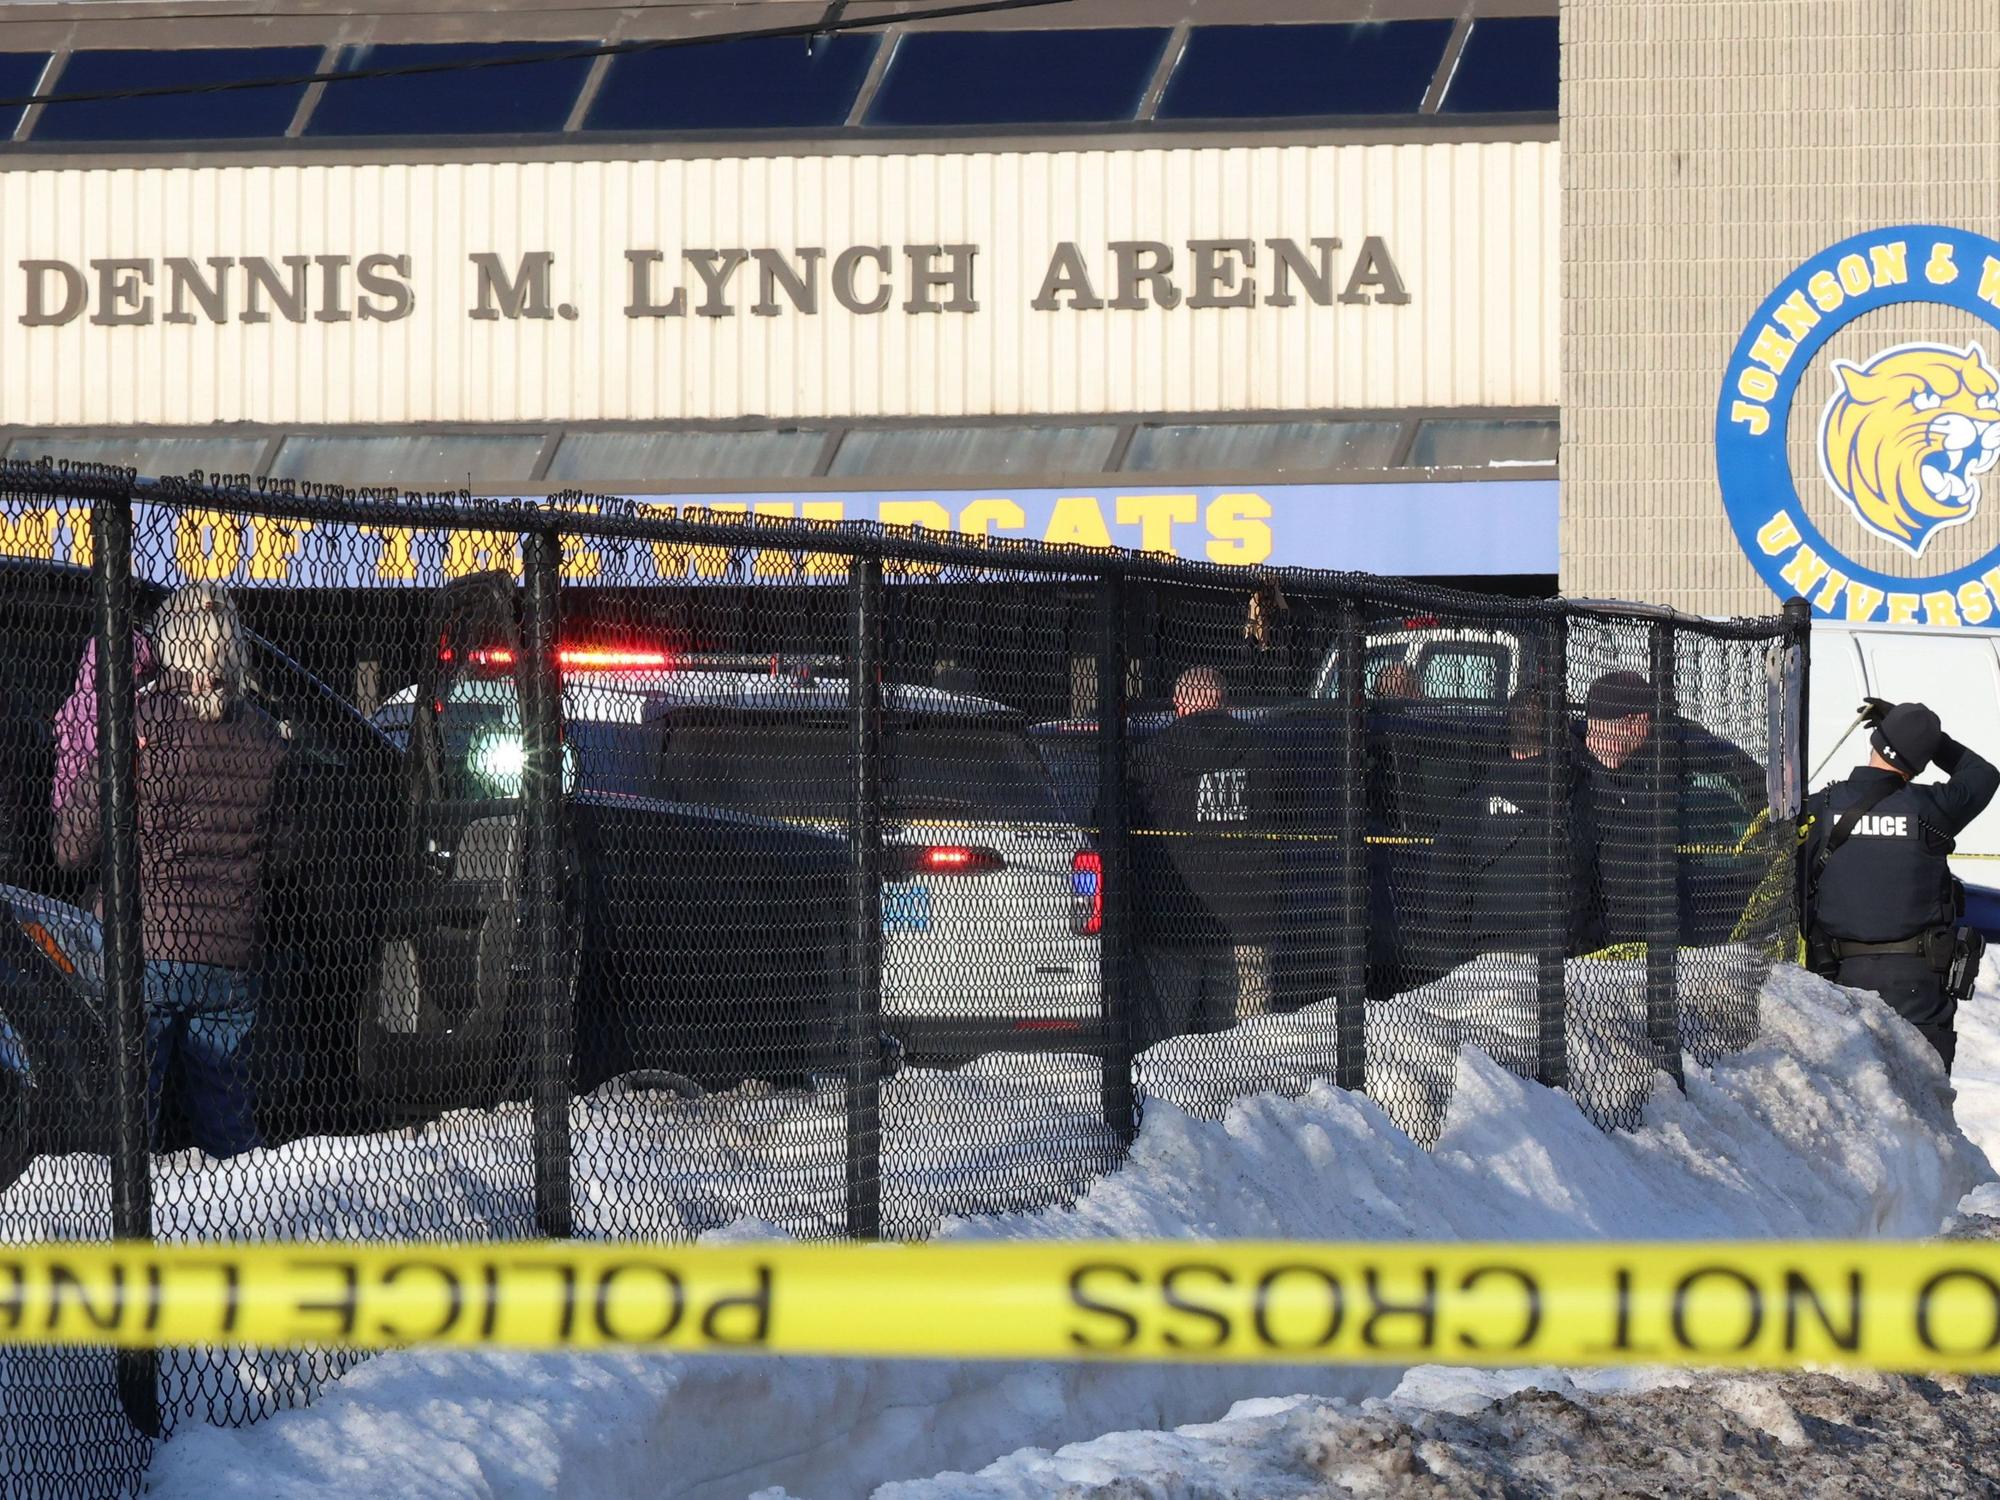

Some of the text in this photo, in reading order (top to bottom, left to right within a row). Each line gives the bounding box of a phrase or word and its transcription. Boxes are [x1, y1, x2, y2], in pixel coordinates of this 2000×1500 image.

[18, 236, 1410, 327] DENNIS M. LYNCH ARENA
[1731, 241, 1908, 435] JOHNSON
[1925, 242, 1959, 285] &
[288, 1262, 774, 1347] POLICE
[1068, 1264, 1542, 1350] CROSS
[1582, 1266, 1863, 1354] NOT
